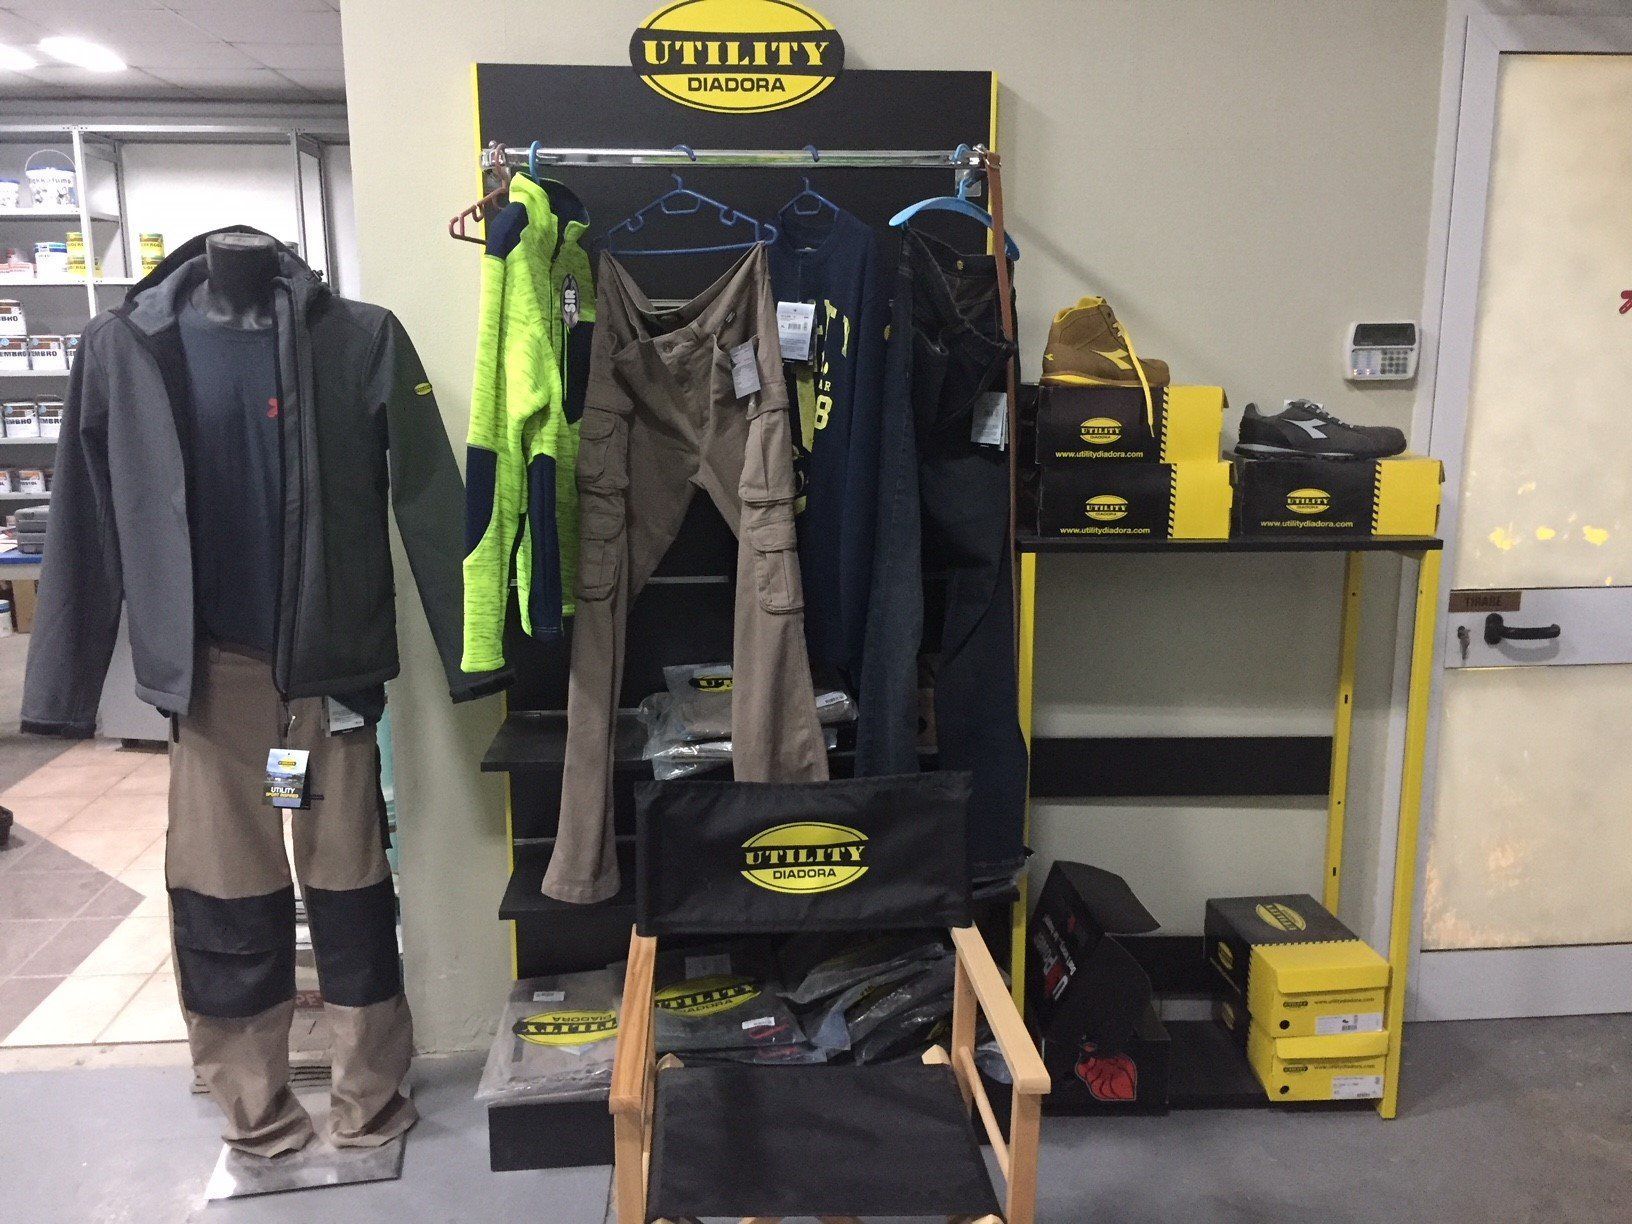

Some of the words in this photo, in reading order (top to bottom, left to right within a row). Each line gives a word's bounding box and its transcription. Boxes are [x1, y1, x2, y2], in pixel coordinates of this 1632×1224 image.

[642, 40, 829, 66] UTILITY
[687, 77, 786, 92] DIADORA
[1055, 450, 1144, 459] www.utilitydiadora.com
[1059, 526, 1151, 535] www.utilitydiadora.com
[1260, 520, 1354, 529] www.utilitydiadora.com
[745, 846, 865, 865] UTILITY
[773, 868, 837, 879] DIADORA
[658, 984, 753, 1008] TILITY
[522, 1020, 618, 1034] TILITY
